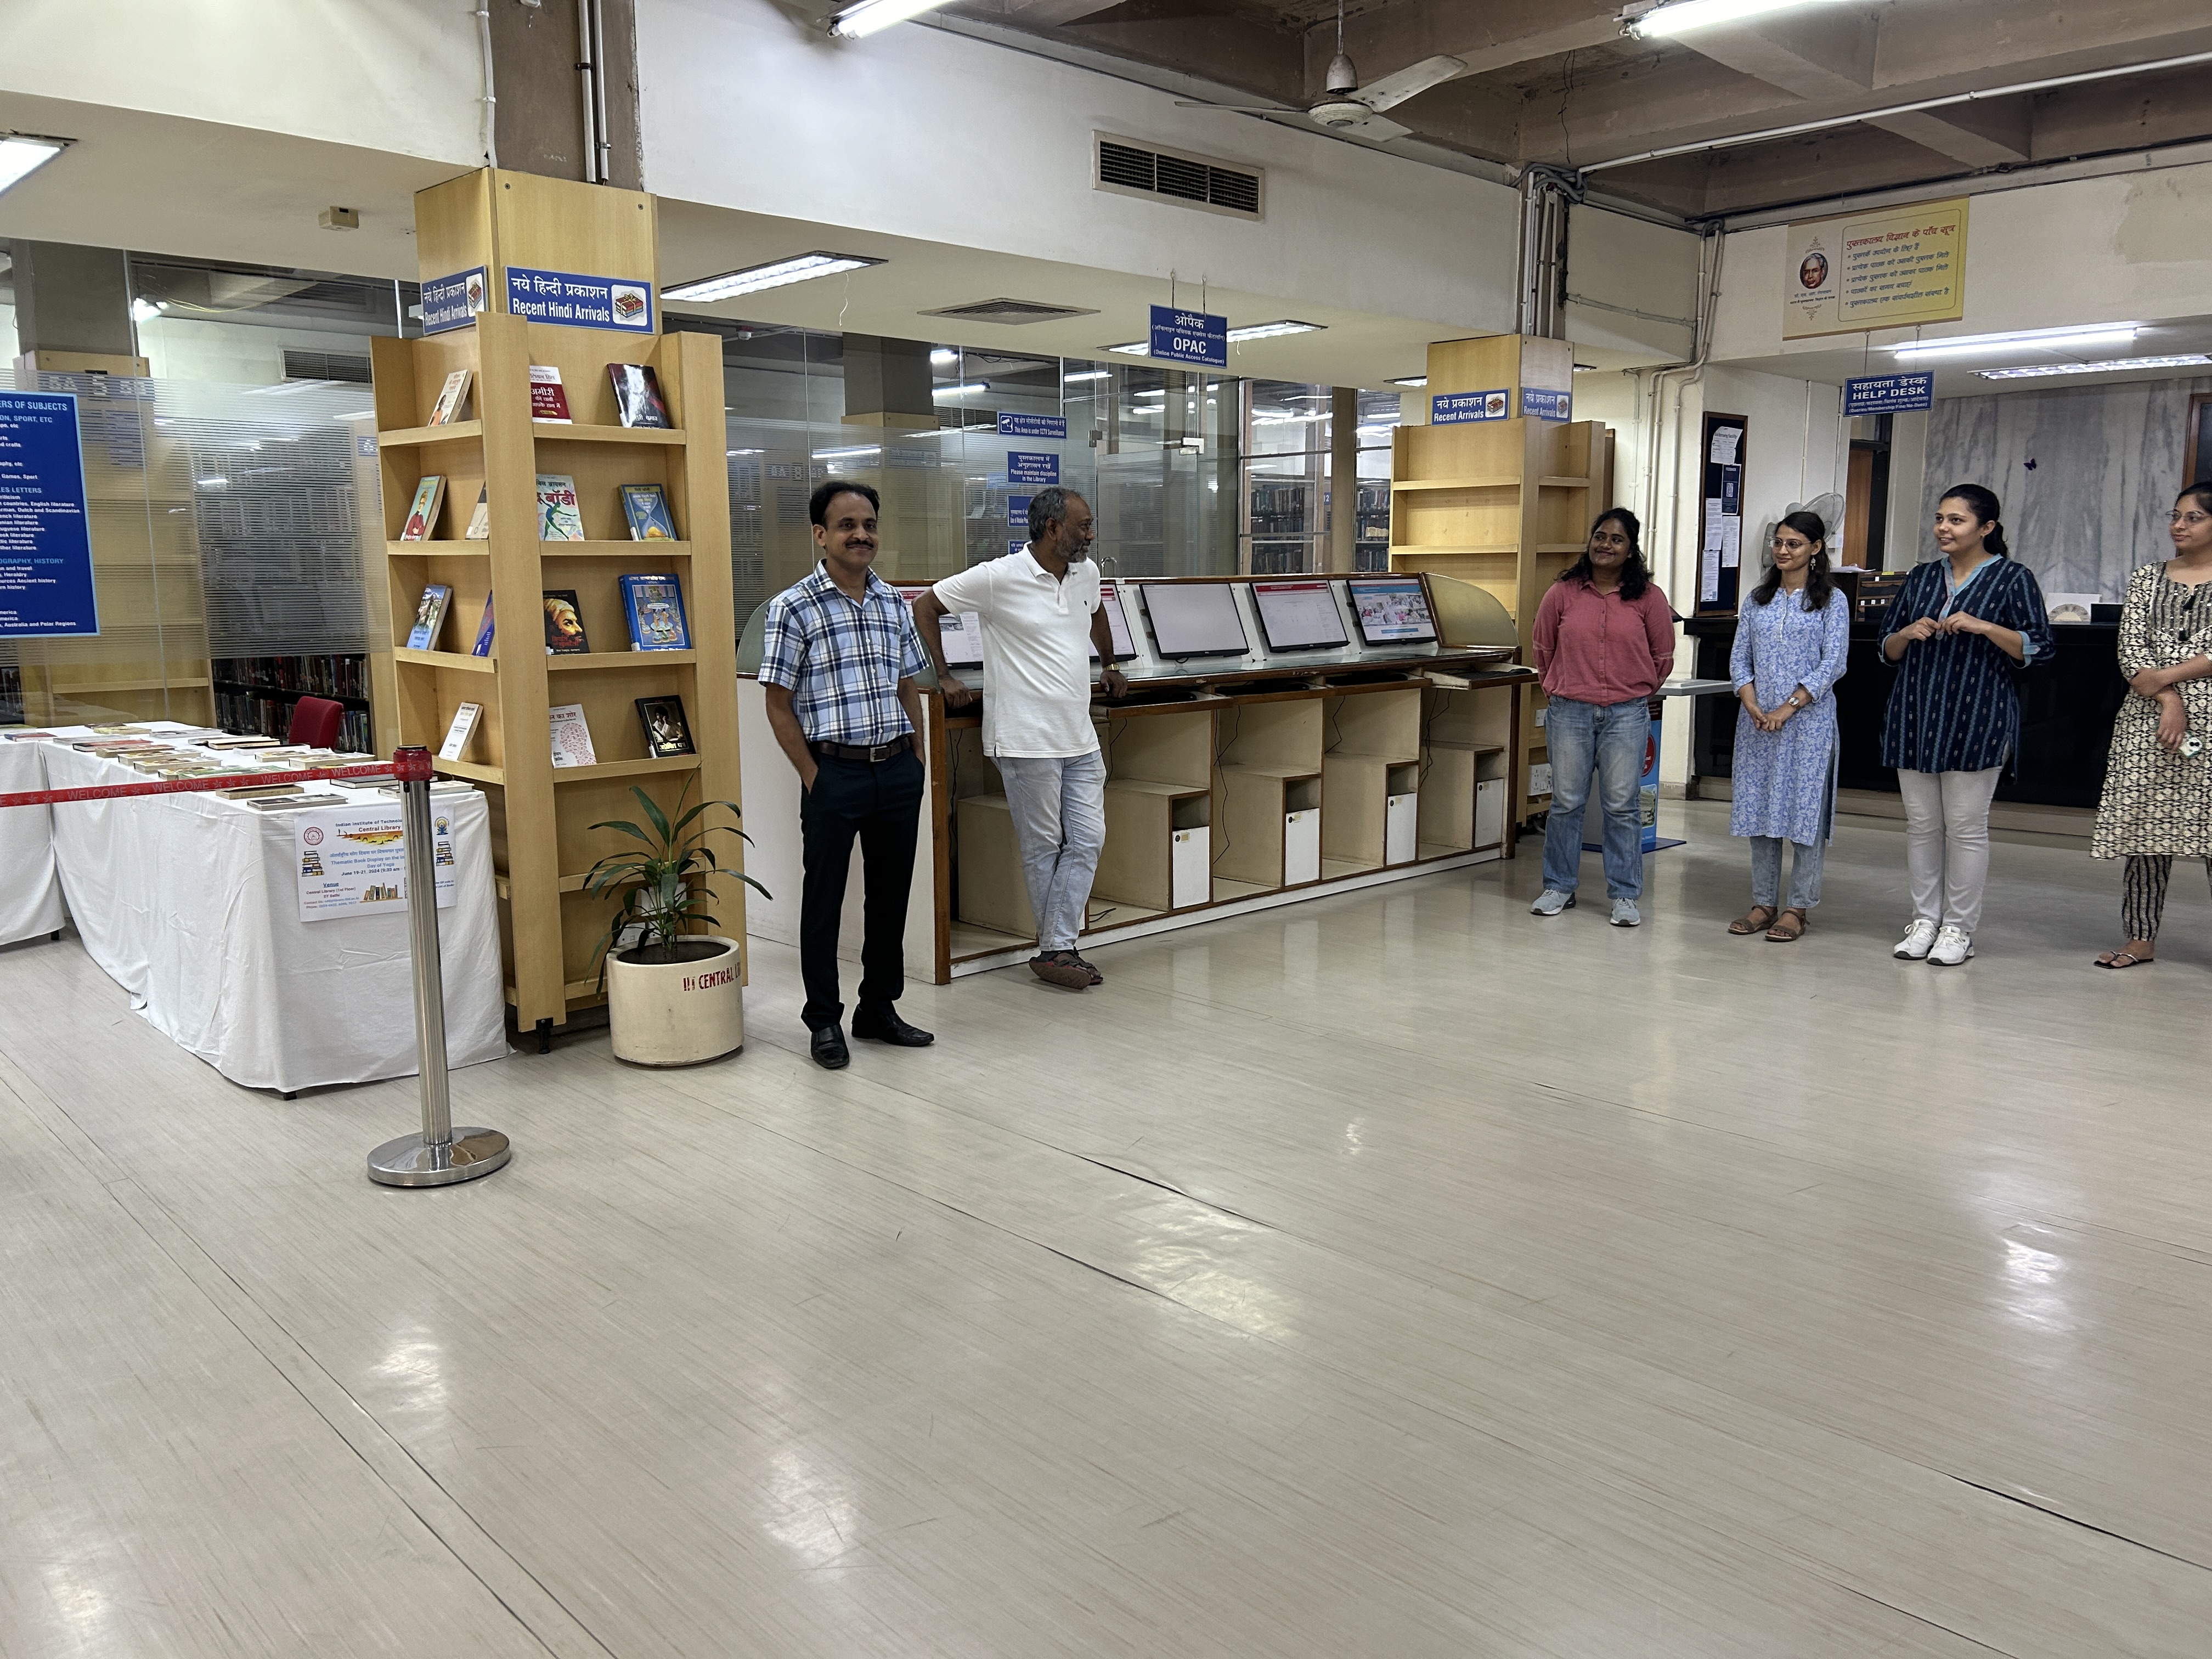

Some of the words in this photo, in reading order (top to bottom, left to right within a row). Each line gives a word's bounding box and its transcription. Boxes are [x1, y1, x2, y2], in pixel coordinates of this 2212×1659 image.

[1847, 236, 1884, 250] पुस्तकालय
[1886, 232, 1910, 241] विज्ञान
[1912, 229, 1920, 237] के
[1916, 254, 1934, 263] पुस्तक
[1870, 273, 1888, 282] पुस्तक
[424, 287, 432, 303] नये
[433, 284, 445, 303] हिन्दी
[446, 283, 465, 298] प्रकाशन
[511, 274, 531, 292] नये
[534, 275, 562, 297] हिन्दी
[565, 283, 608, 300] प्रकाशन
[425, 309, 439, 326] Recent
[439, 307, 450, 323] Hindi
[452, 302, 467, 320] Arrivals
[513, 298, 546, 316] Recent
[549, 301, 572, 318] Hindi
[575, 304, 610, 322] Arrivals
[1174, 313, 1204, 329] ओपैक
[1173, 337, 1206, 354] OPAC
[1202, 356, 1224, 365] Catalogue)
[531, 386, 555, 396] अमीरी
[1852, 380, 1895, 391] सहायता
[1898, 376, 1928, 386] डेस्क
[1526, 391, 1534, 403] नये
[1535, 393, 1555, 405] प्रकाशन
[1853, 390, 1886, 400] HELP
[1890, 386, 1926, 397] DESK
[27, 402, 67, 411] SUBJECTS
[1436, 397, 1449, 409] नये
[1451, 397, 1483, 408] प्रकाशन
[1434, 412, 1457, 421] Recent
[1458, 410, 1484, 420] Arrivals
[1523, 405, 1538, 416] Recent
[1539, 407, 1555, 417] Arrivals
[544, 489, 575, 506] बॉडी
[67, 787, 127, 800] WELCOME
[152, 780, 209, 793] WELCOME
[261, 772, 313, 785] WELCOME
[331, 765, 381, 777] WELCOME
[699, 967, 734, 989] CENTRAL
